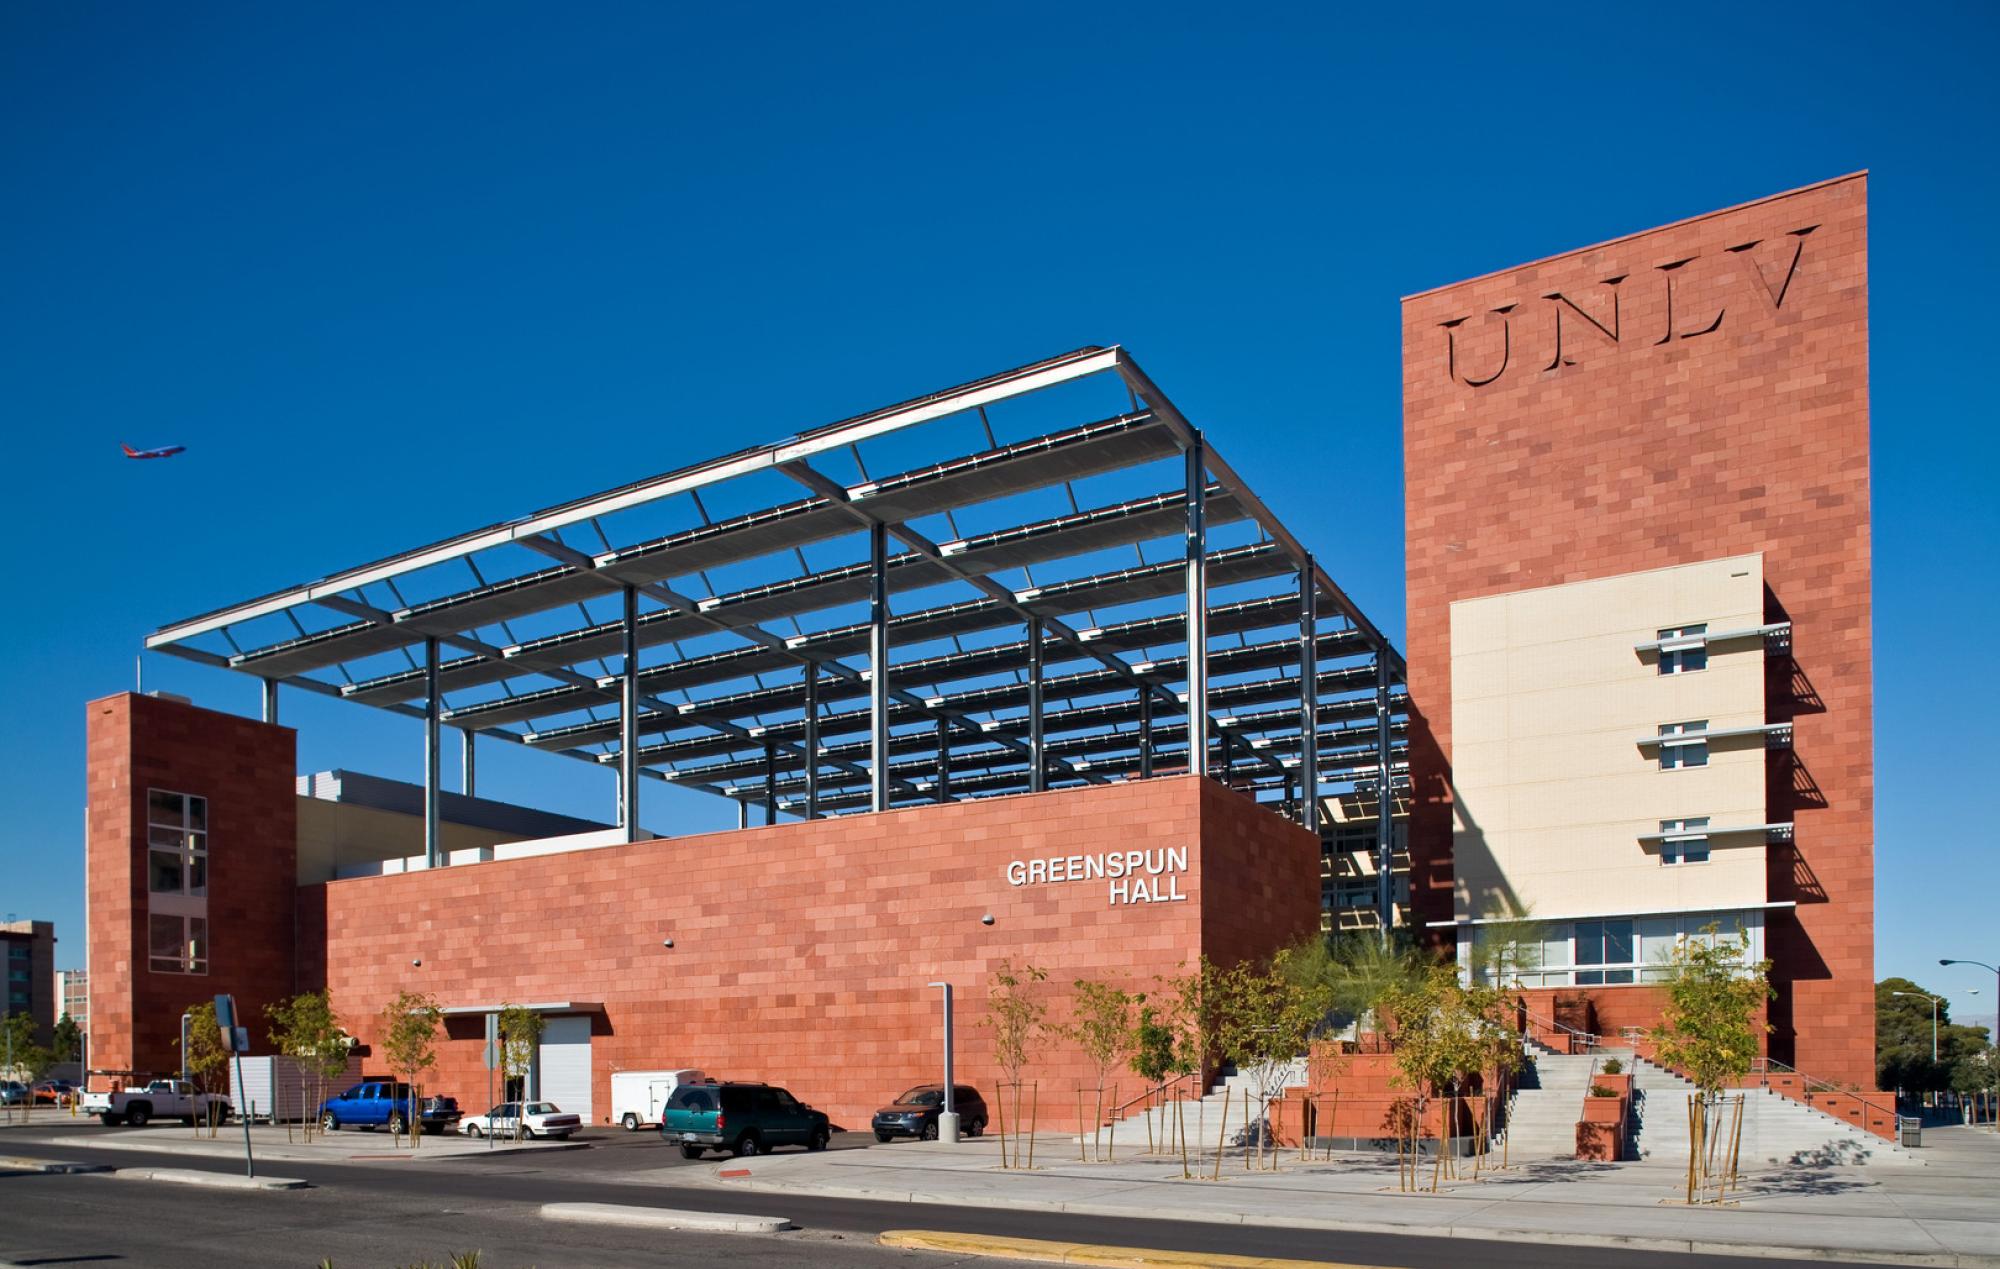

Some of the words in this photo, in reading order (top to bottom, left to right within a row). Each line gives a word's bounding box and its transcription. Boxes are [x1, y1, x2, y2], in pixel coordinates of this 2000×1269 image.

[1437, 224, 1821, 387] UNLV
[1007, 846, 1188, 886] GREENSPUN
[1109, 876, 1187, 905] HALL
